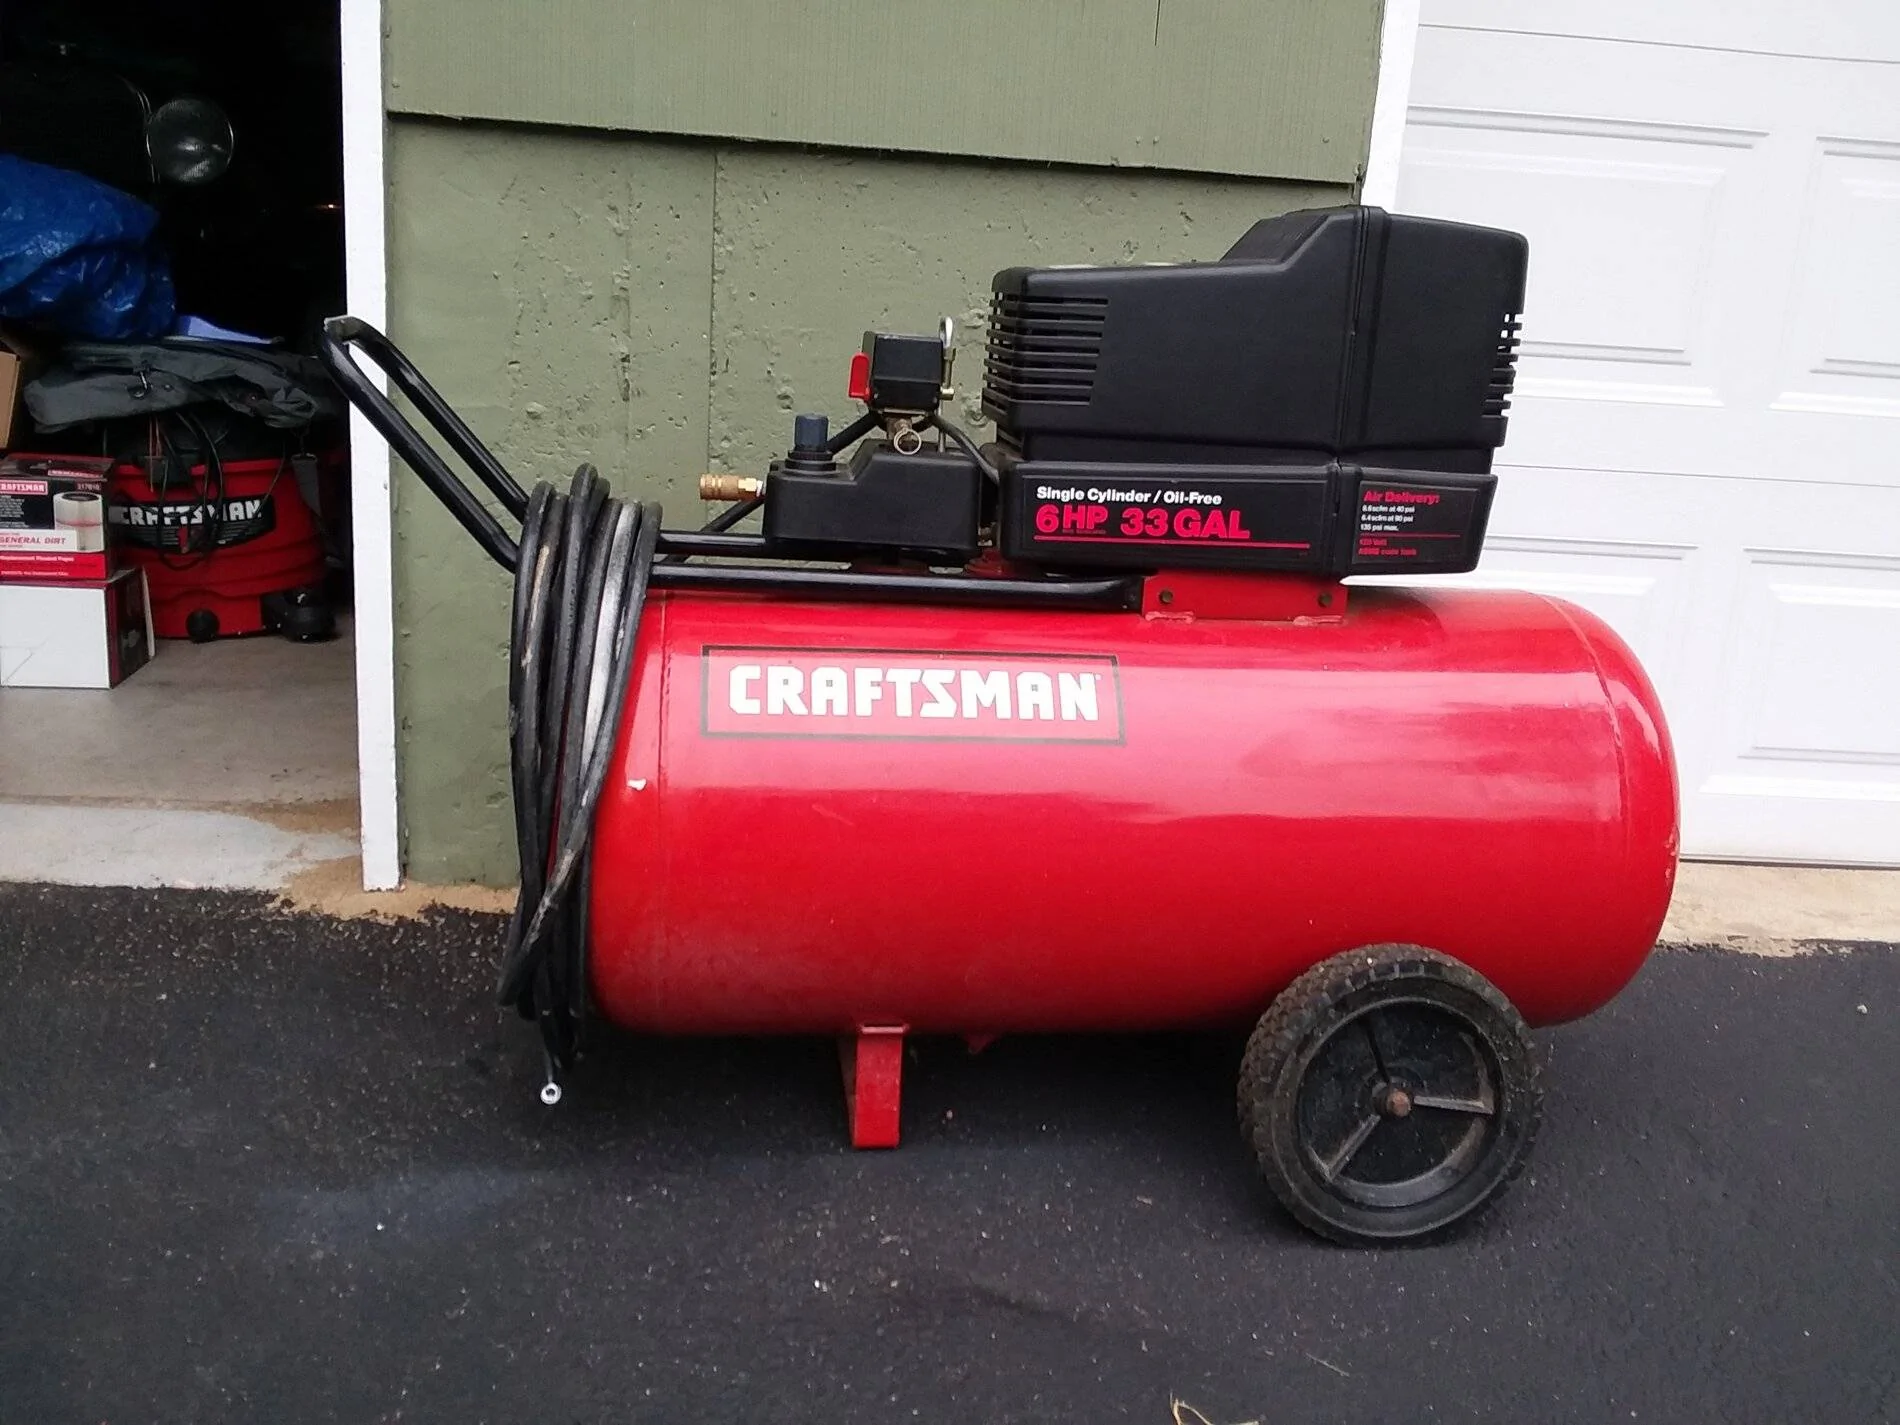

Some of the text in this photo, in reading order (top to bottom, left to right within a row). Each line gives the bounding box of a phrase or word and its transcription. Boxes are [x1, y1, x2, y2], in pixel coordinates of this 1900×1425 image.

[0, 483, 45, 492] RAFTSMAN
[1036, 486, 1223, 505] Single Cylinder / Oil-Free
[1363, 490, 1440, 505] Air Delivery:
[1120, 507, 1169, 537] 33
[1173, 508, 1250, 539] GAL
[0, 536, 66, 545] GENERAL DIRT
[728, 664, 1099, 721] CRAFTSMAN
